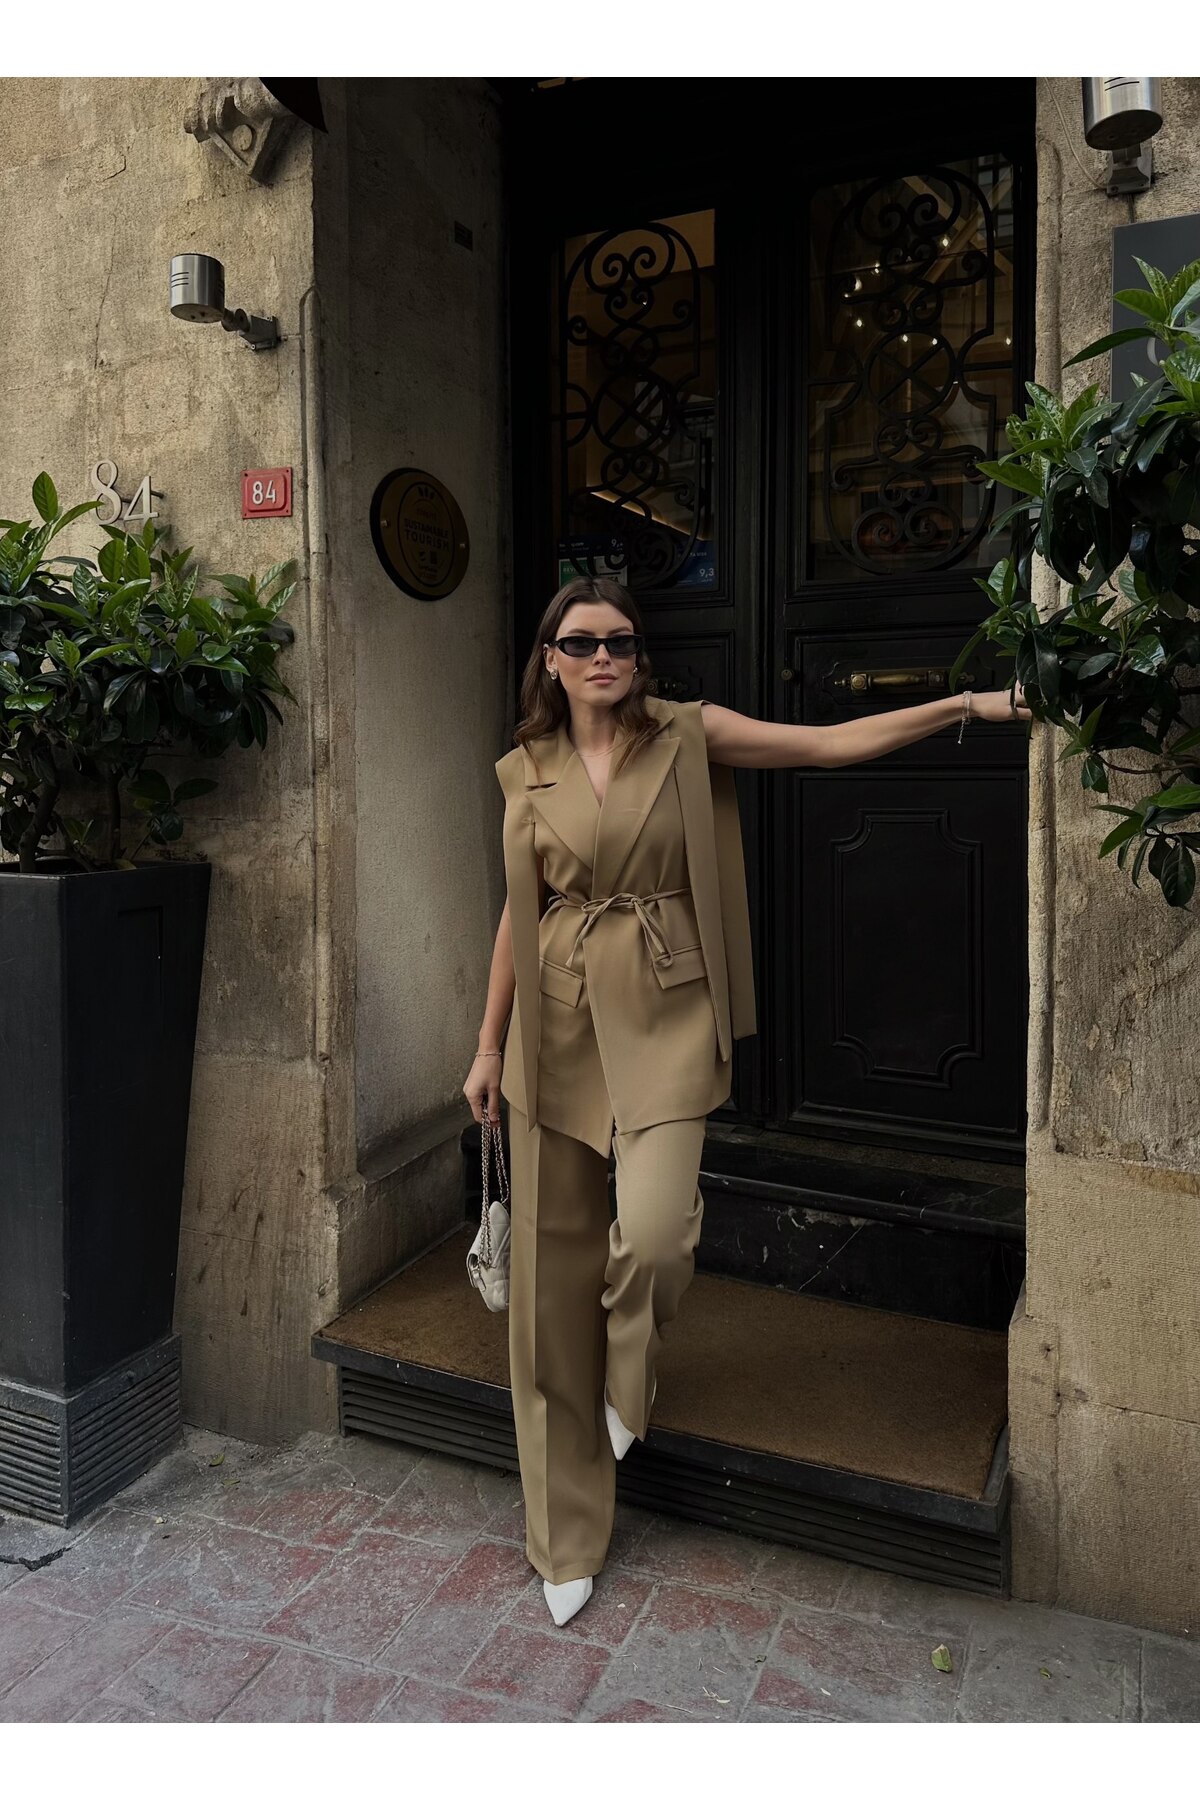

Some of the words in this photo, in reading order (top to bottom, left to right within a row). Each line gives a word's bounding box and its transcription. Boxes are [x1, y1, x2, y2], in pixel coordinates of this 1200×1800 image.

[91, 459, 159, 526] 84
[252, 480, 276, 505] 84
[404, 518, 449, 538] SUSTAINABLE
[405, 529, 449, 550] TOURISM
[699, 567, 715, 578] 9,3
